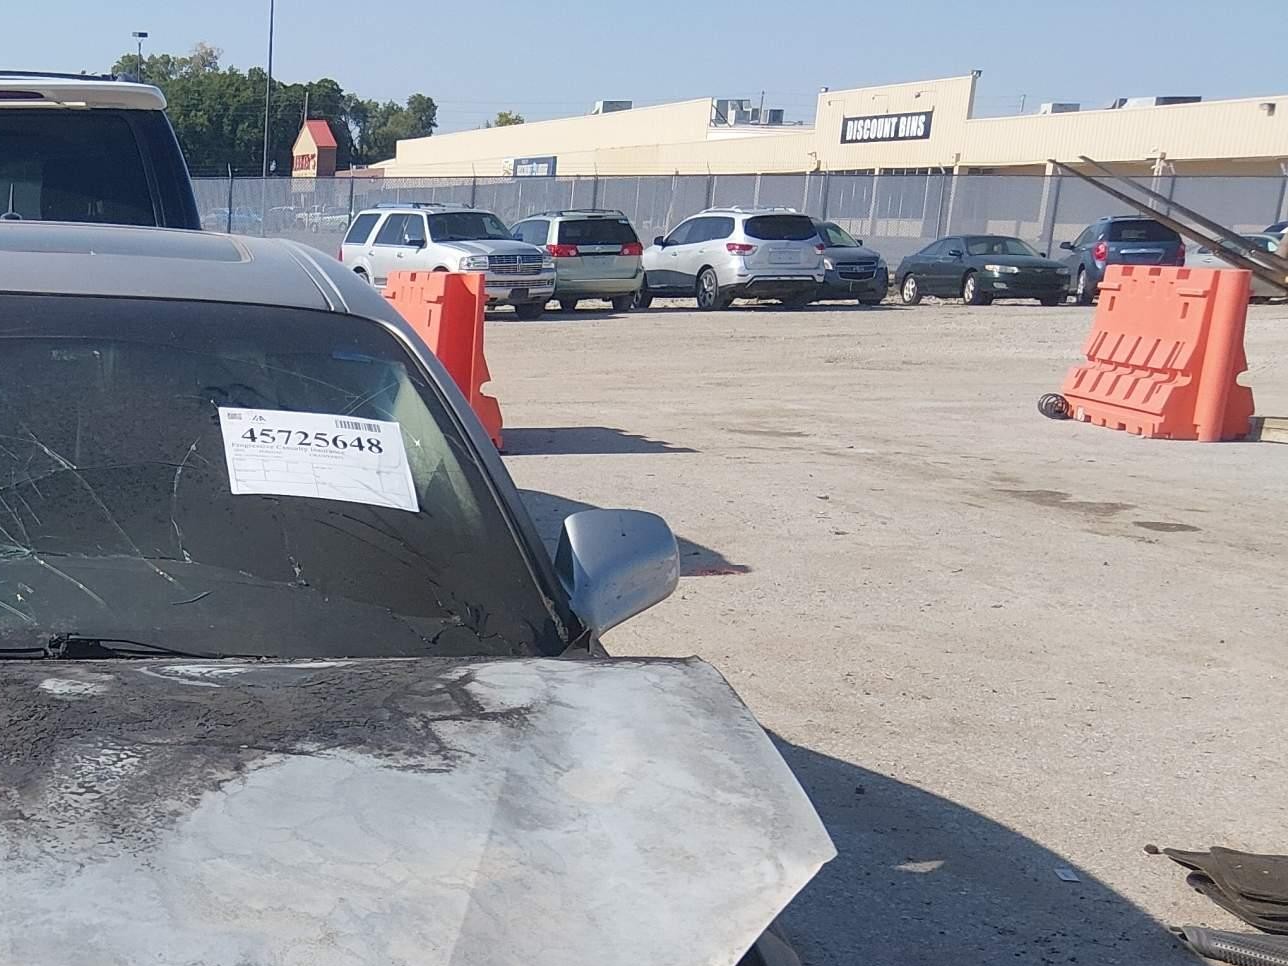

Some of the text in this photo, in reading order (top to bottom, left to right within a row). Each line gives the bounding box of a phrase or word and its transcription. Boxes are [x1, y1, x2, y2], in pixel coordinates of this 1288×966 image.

[845, 114, 926, 141] DISCOUNT BINS
[241, 427, 384, 454] 45725648
